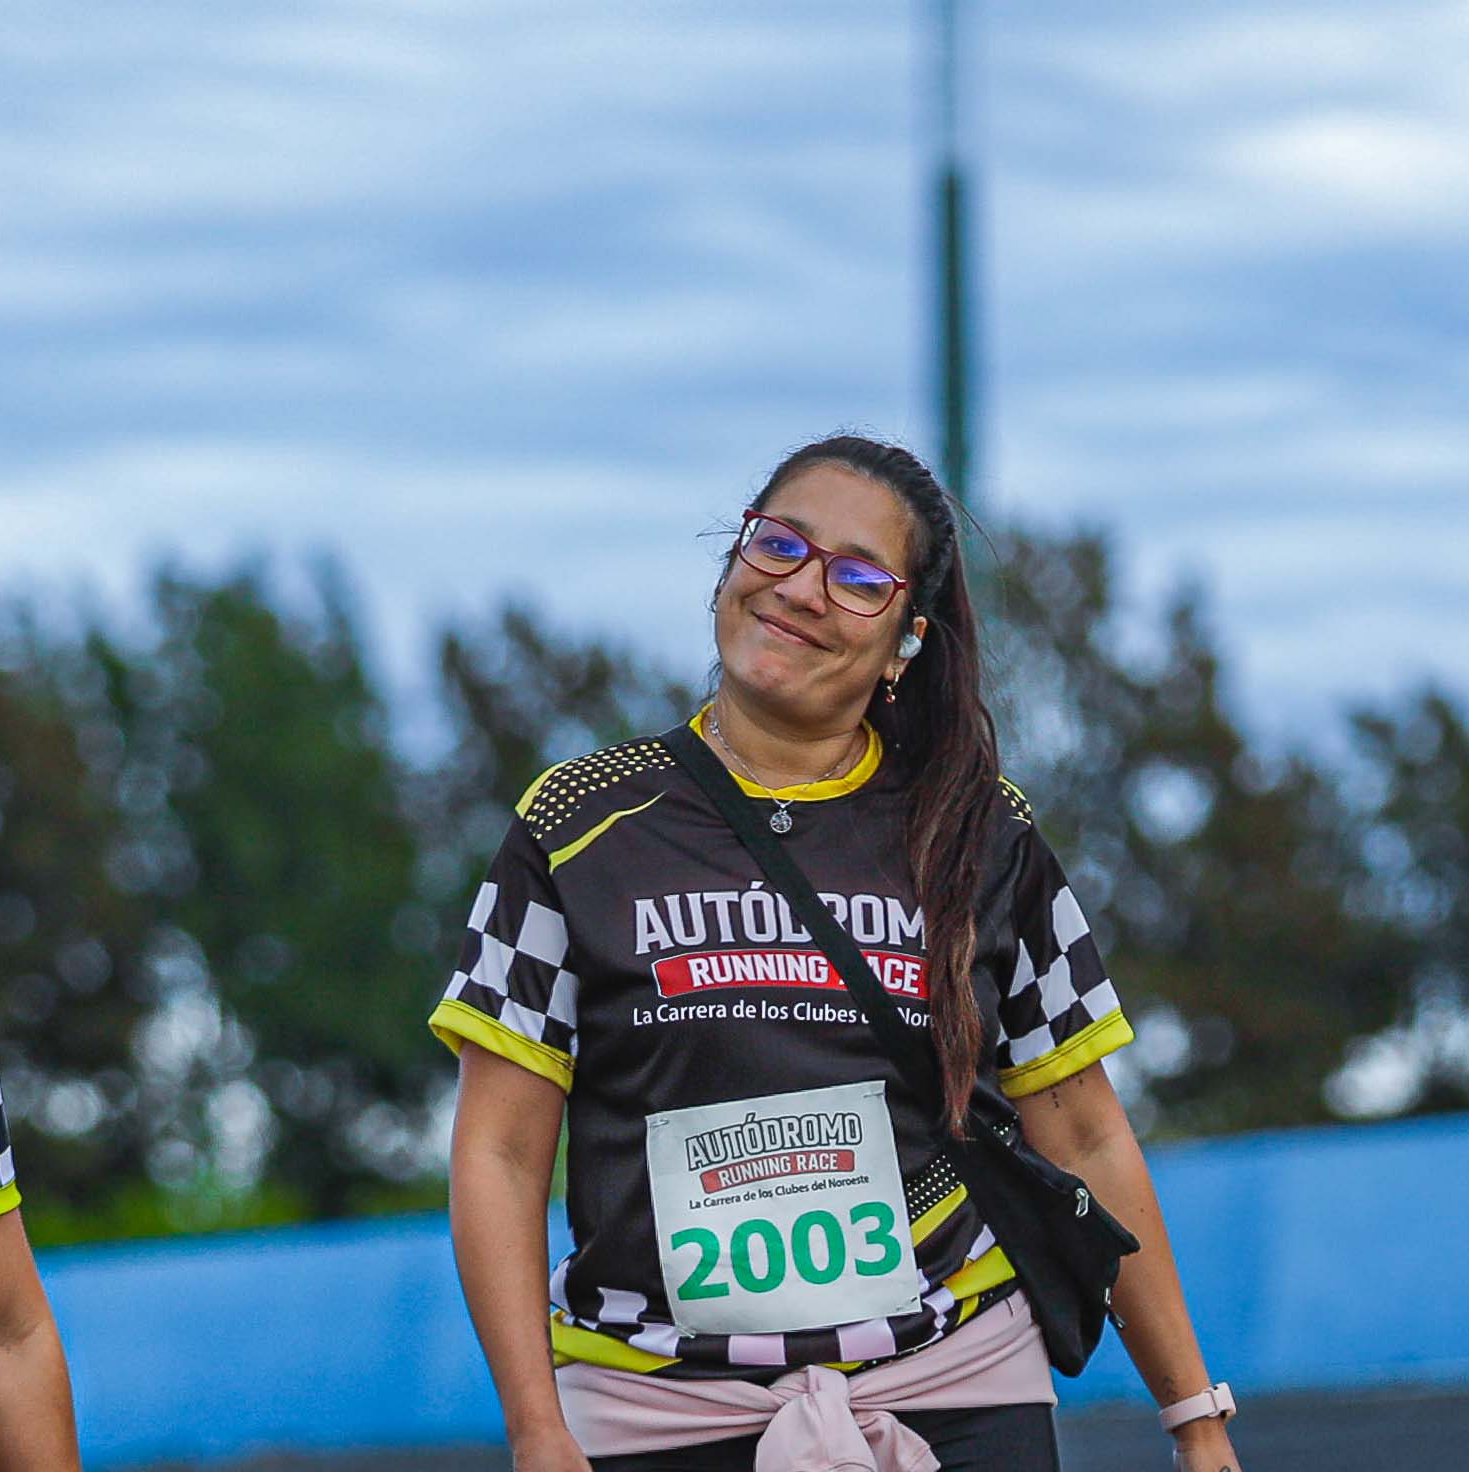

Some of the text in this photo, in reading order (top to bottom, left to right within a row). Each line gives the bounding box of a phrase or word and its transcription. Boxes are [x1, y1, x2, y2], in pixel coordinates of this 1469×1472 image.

[634, 880, 927, 955] AUTÓDROM
[687, 953, 829, 988] RUNNING
[633, 1006, 652, 1026] La
[656, 1001, 727, 1022] Carrera
[732, 999, 757, 1020] de
[761, 1000, 789, 1020] los
[793, 1001, 857, 1024] Clubes
[685, 1112, 863, 1172] AUTÓDROMO
[717, 1152, 838, 1188] RUNNING RACE
[689, 1174, 870, 1210] La Carrera de los Clubes del Noroeste
[670, 1201, 902, 1301] 2003
